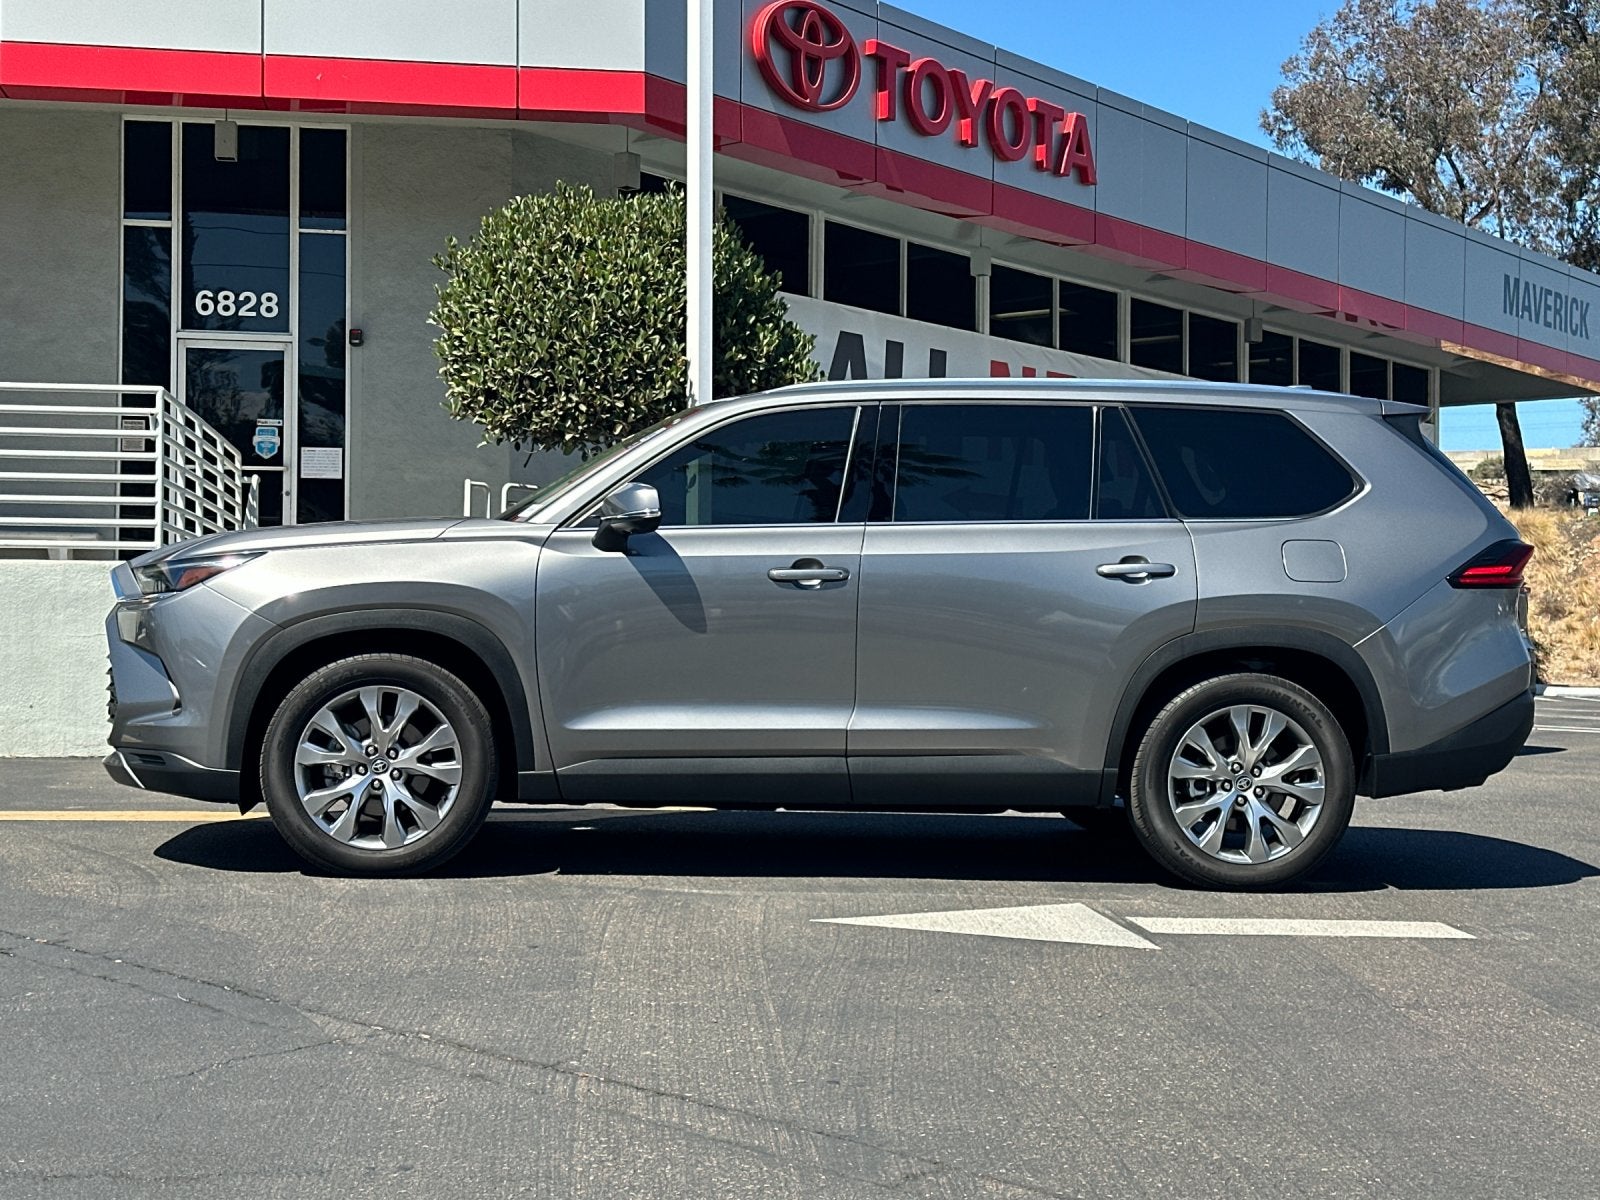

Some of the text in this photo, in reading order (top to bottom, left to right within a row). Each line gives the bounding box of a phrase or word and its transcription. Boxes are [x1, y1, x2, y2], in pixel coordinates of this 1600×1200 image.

[865, 39, 1097, 185] TOYOTA
[195, 289, 279, 318] 6828
[1503, 273, 1590, 340] MAVERICK
